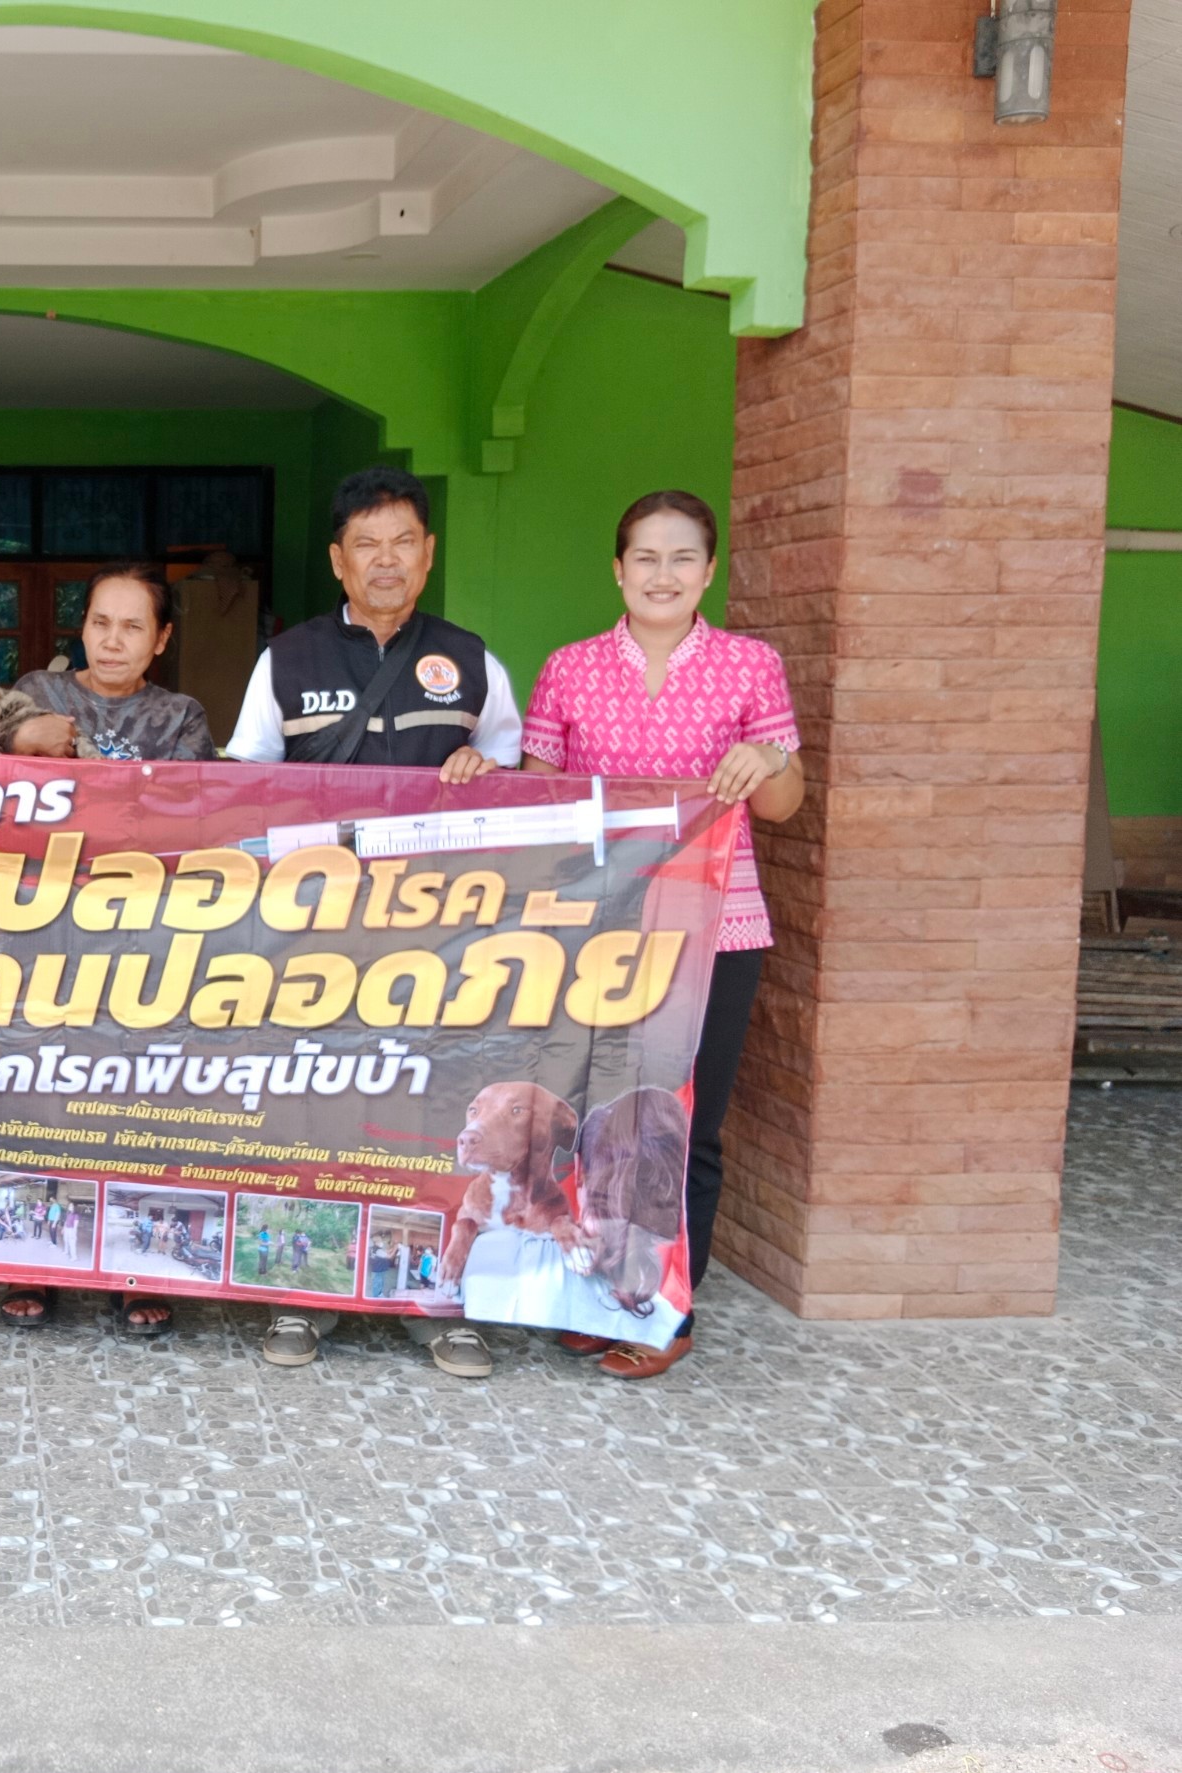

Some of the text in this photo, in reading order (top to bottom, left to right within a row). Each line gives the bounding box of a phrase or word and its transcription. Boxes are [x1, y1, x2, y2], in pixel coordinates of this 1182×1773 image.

[301, 690, 356, 714] DLD
[315, 1173, 416, 1201] จังหวัดพัทลุง
